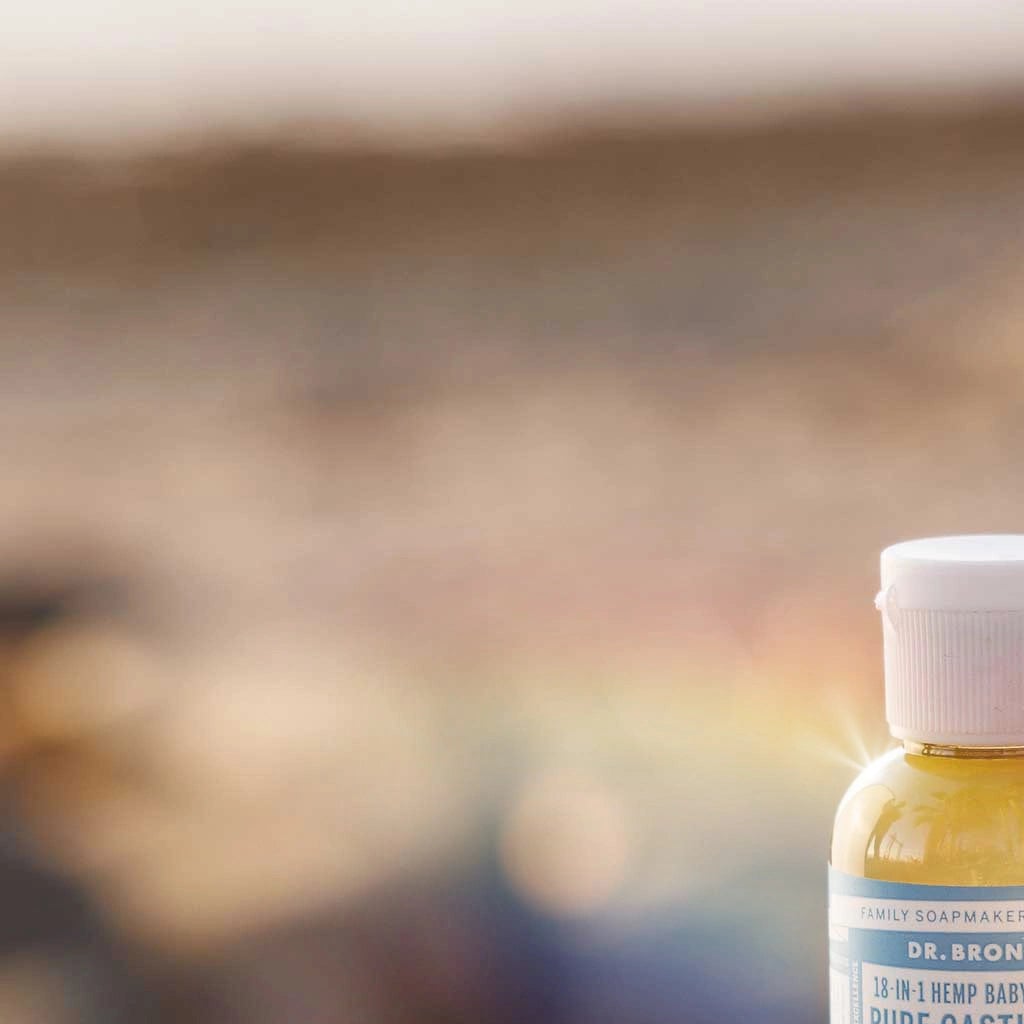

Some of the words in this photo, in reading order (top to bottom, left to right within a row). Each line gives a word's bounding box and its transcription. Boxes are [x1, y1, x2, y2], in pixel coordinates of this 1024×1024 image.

[861, 906, 909, 921] FAMILY
[908, 941, 946, 961] DR.
[874, 976, 925, 1002] 18-IN-1
[931, 982, 977, 1005] HEMP
